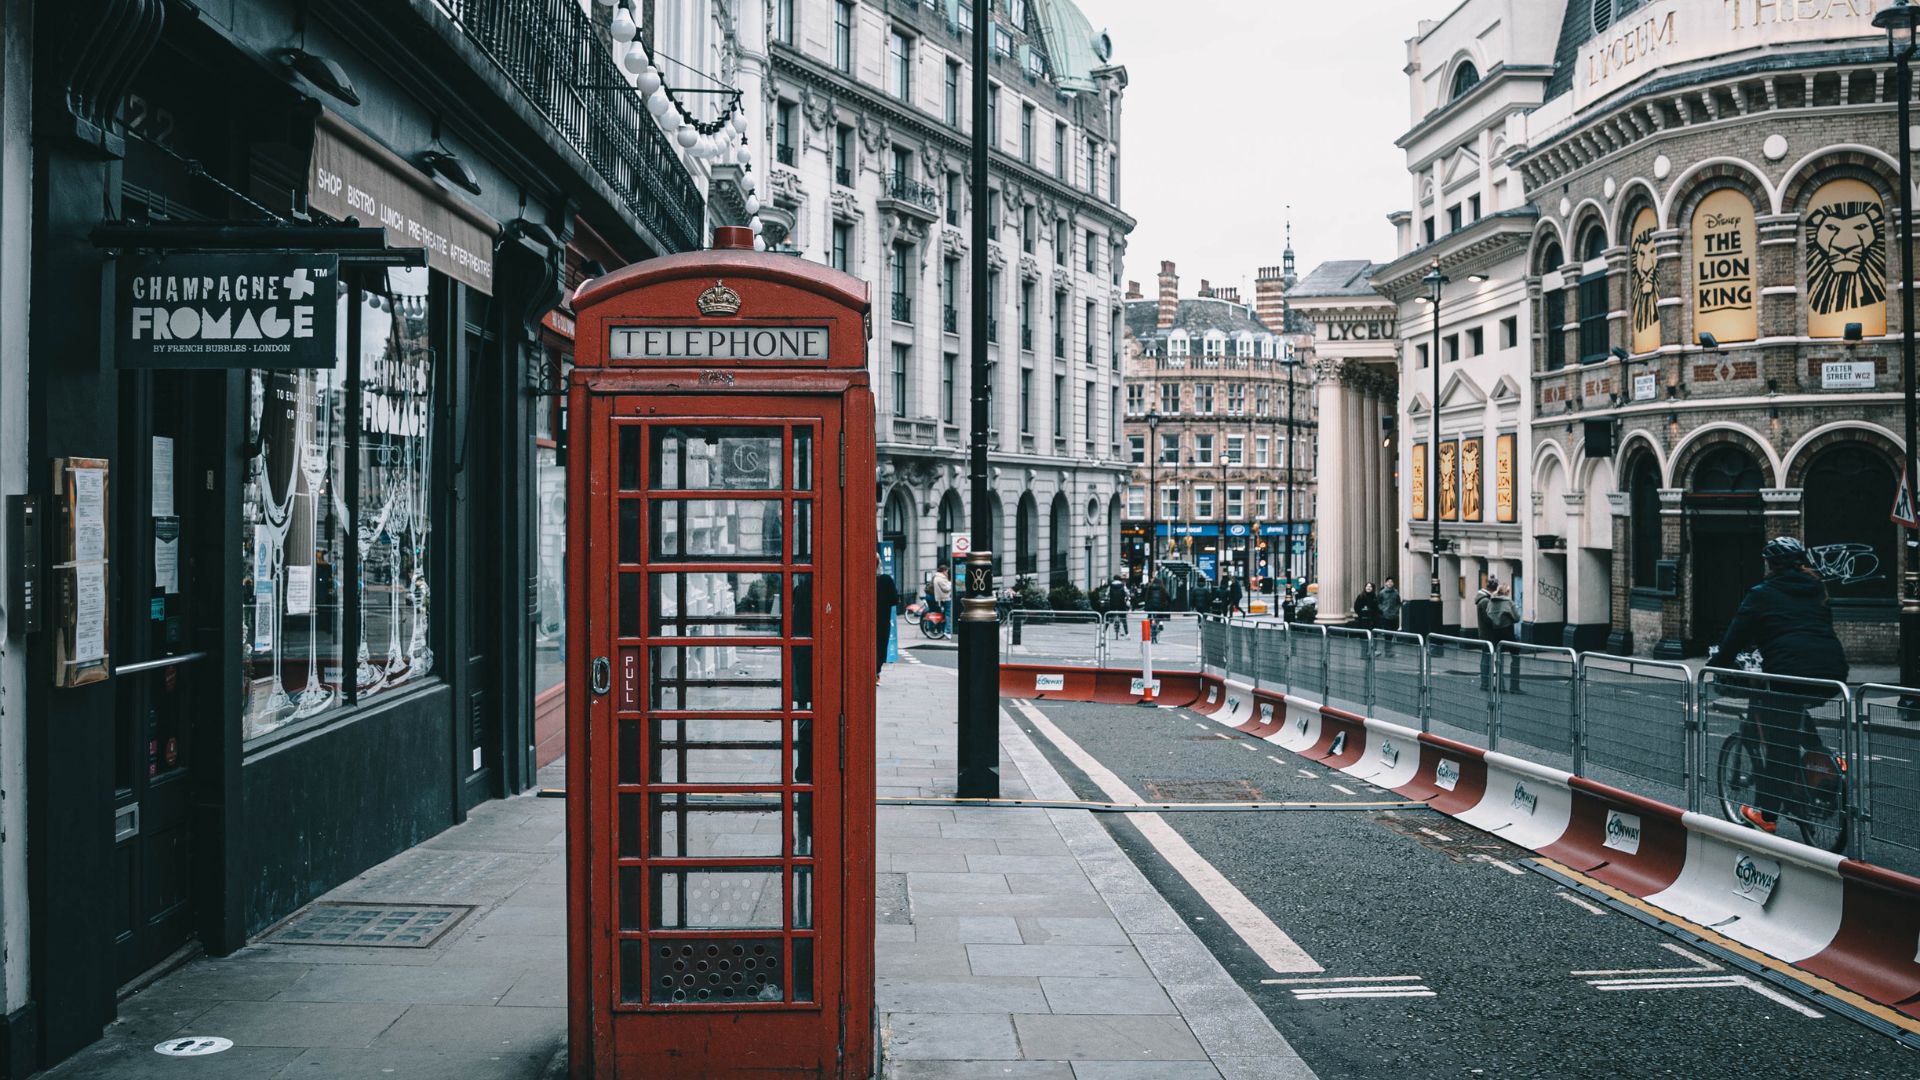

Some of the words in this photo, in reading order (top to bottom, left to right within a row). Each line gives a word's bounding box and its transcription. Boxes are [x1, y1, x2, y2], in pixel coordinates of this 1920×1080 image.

[1589, 10, 1678, 87] LYCEUM
[318, 167, 342, 197] SHOP
[347, 185, 375, 216] BISTRO
[380, 203, 404, 233] LUNCH
[408, 219, 448, 256] PRE-THEATRE
[450, 243, 491, 278] AFTER-THEATRE
[1704, 230, 1742, 252] THE
[1699, 258, 1749, 280] LION
[132, 275, 280, 303] CHAMPAGNE
[1699, 286, 1752, 308] KING
[132, 306, 315, 341] FROMAGE
[1327, 320, 1400, 341] LYCEU
[153, 344, 165, 352] BY
[167, 344, 203, 352] FRENCH
[205, 344, 247, 352] BUBBLES
[253, 344, 291, 352] LONDON
[619, 330, 820, 357] TELEPHONE
[290, 373, 298, 385] TO
[1825, 365, 1852, 373] EXETER
[1826, 372, 1852, 381] STREET
[1854, 372, 1871, 380] WC2
[276, 389, 284, 400] TO
[286, 409, 295, 420] OR
[362, 390, 427, 437] FROMAGE
[625, 656, 634, 703] PULL
[1607, 815, 1640, 841] CONWAY
